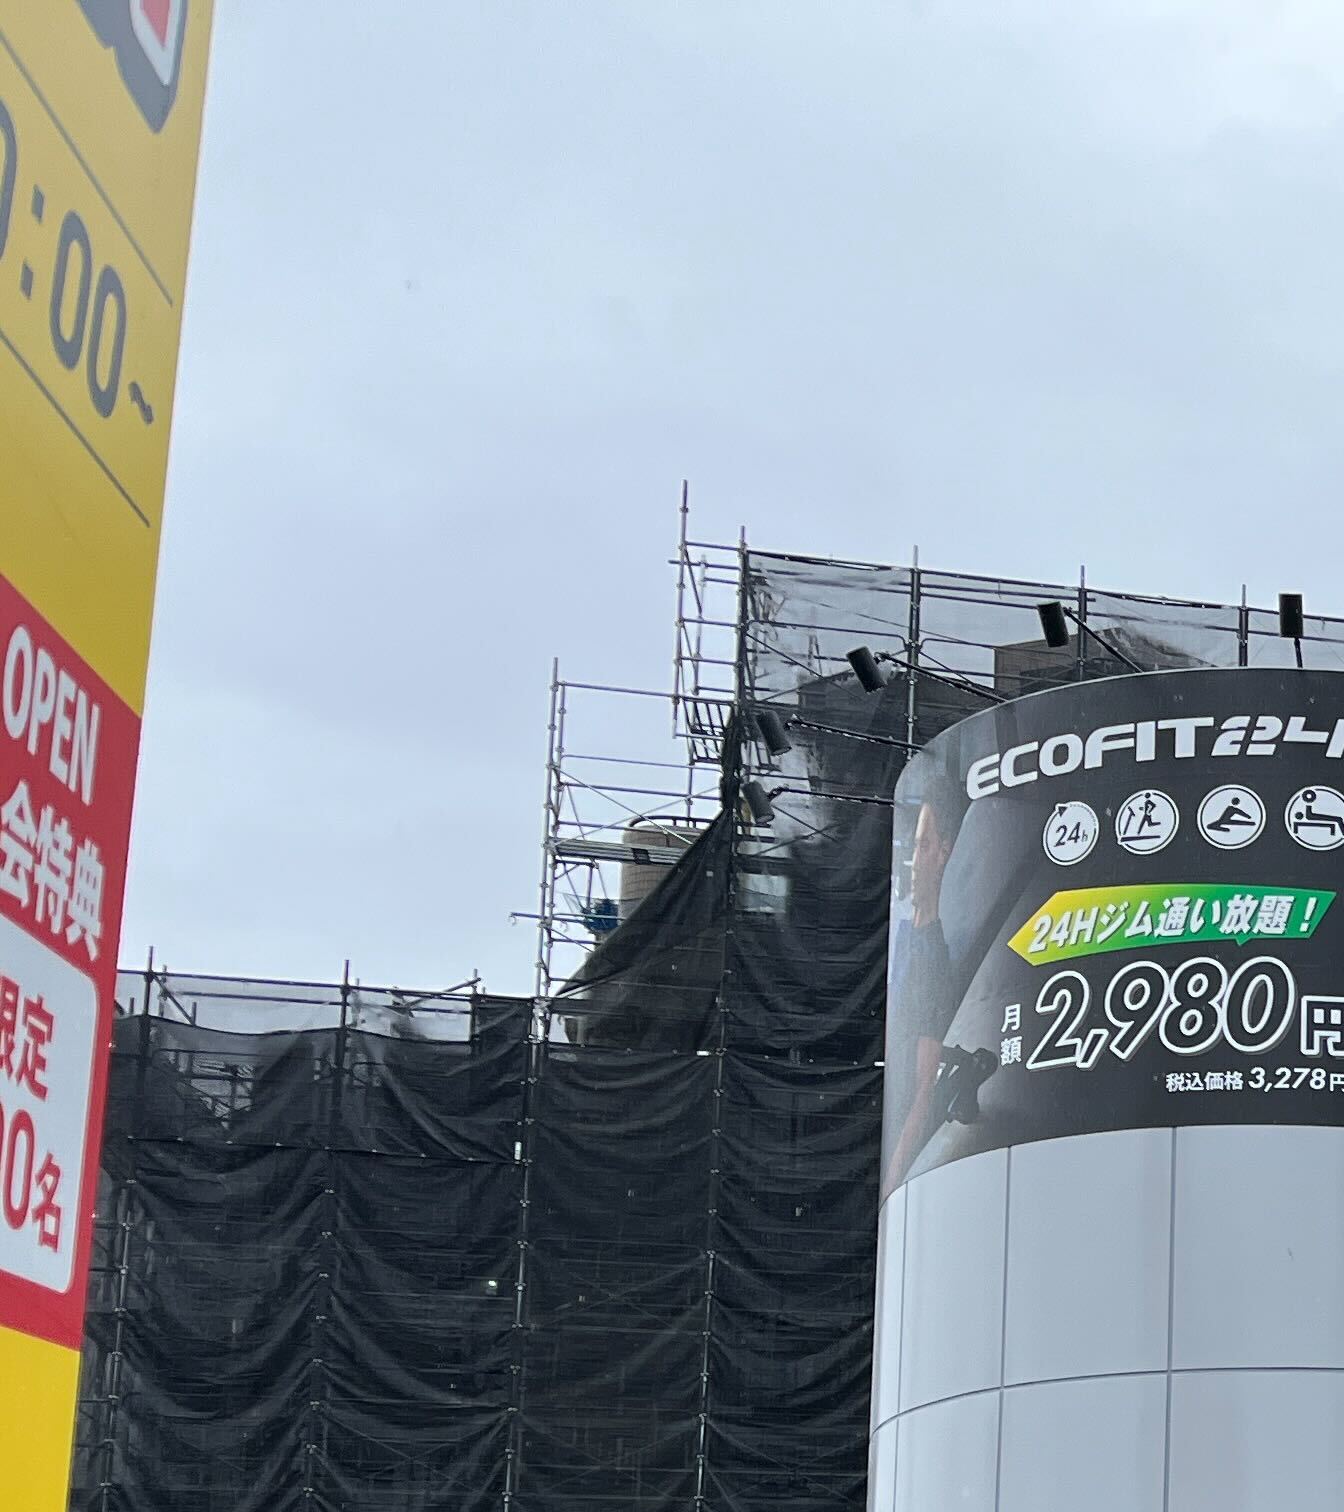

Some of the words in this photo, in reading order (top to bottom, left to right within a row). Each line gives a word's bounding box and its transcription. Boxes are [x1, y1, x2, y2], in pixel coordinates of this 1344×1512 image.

[2, 624, 100, 807] OPEN
[0, 778, 105, 961] 会特典
[1054, 821, 1088, 847] 24h
[1001, 1004, 1023, 1067] 月額
